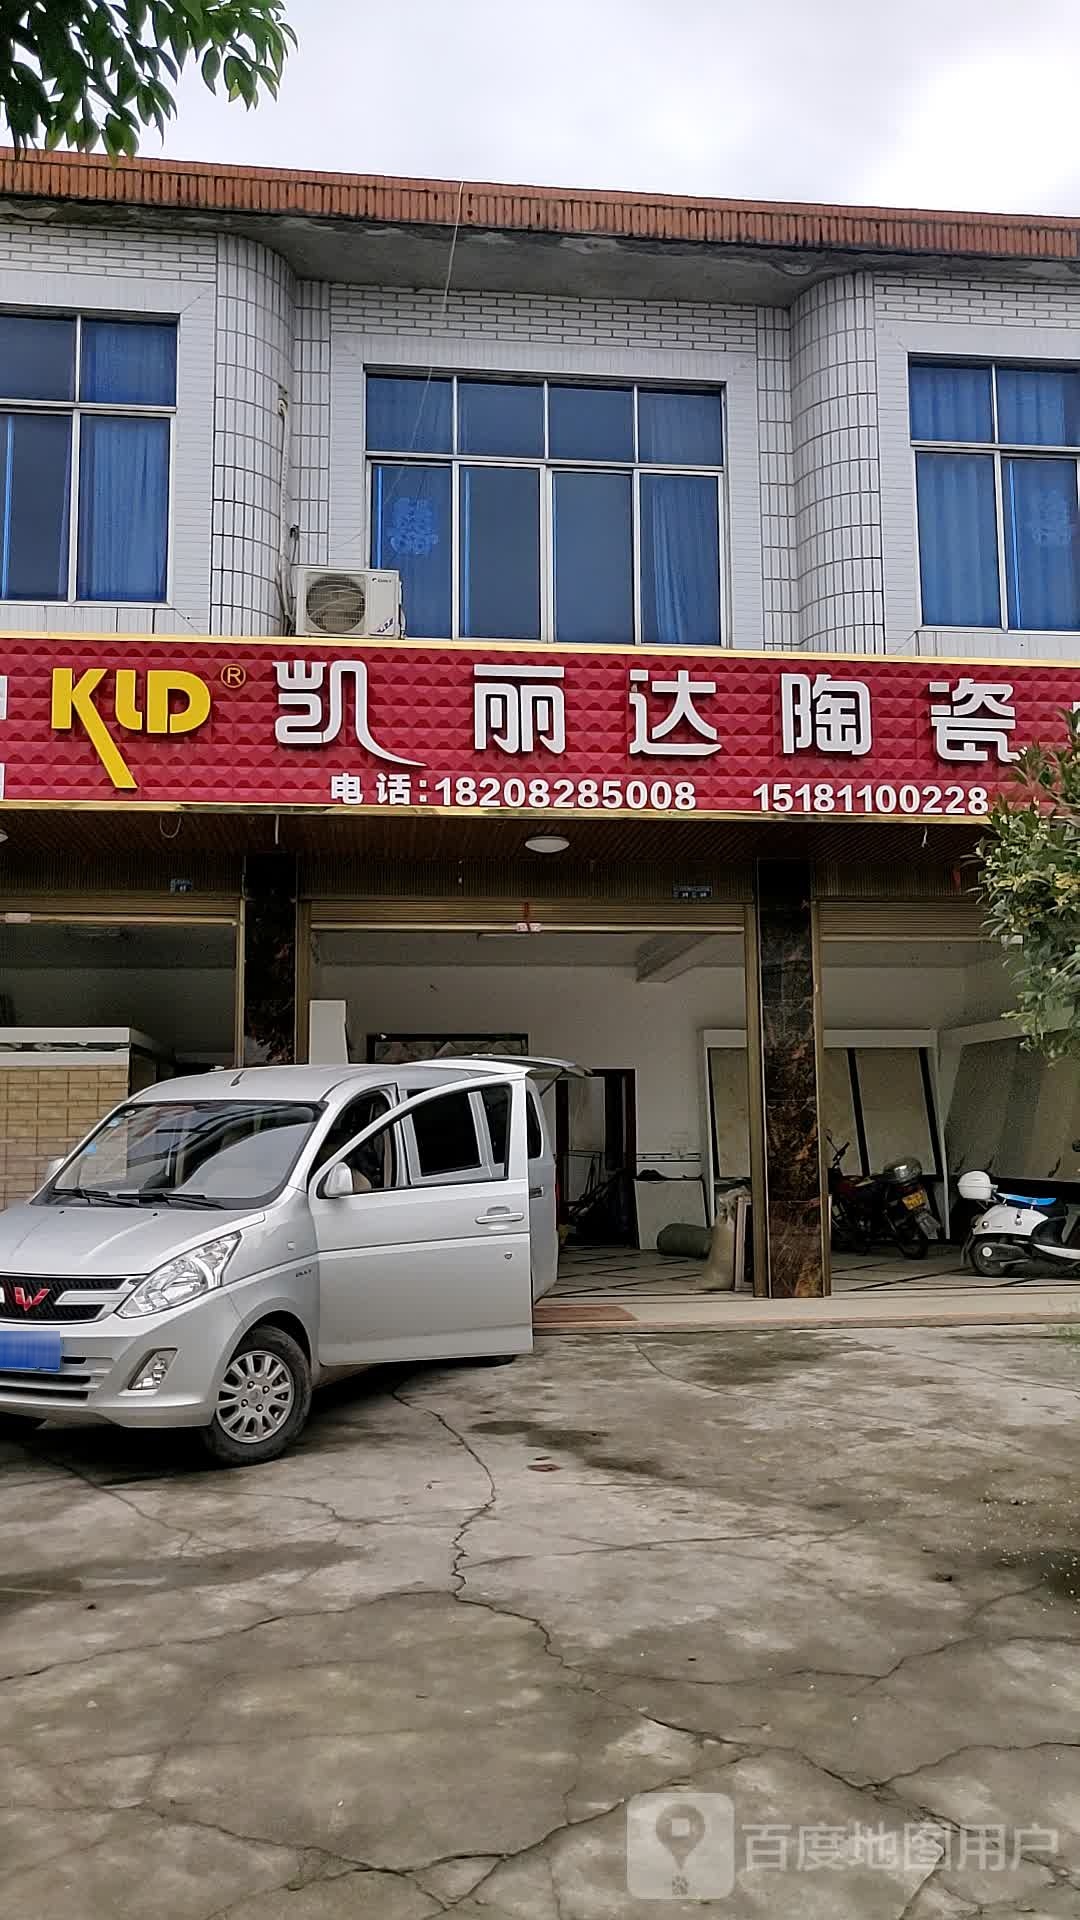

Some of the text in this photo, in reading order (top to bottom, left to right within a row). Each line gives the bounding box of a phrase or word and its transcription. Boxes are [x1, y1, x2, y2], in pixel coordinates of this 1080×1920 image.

[272, 659, 1021, 767] 凯丽达陶瓷
[752, 782, 989, 815] 15181100228
